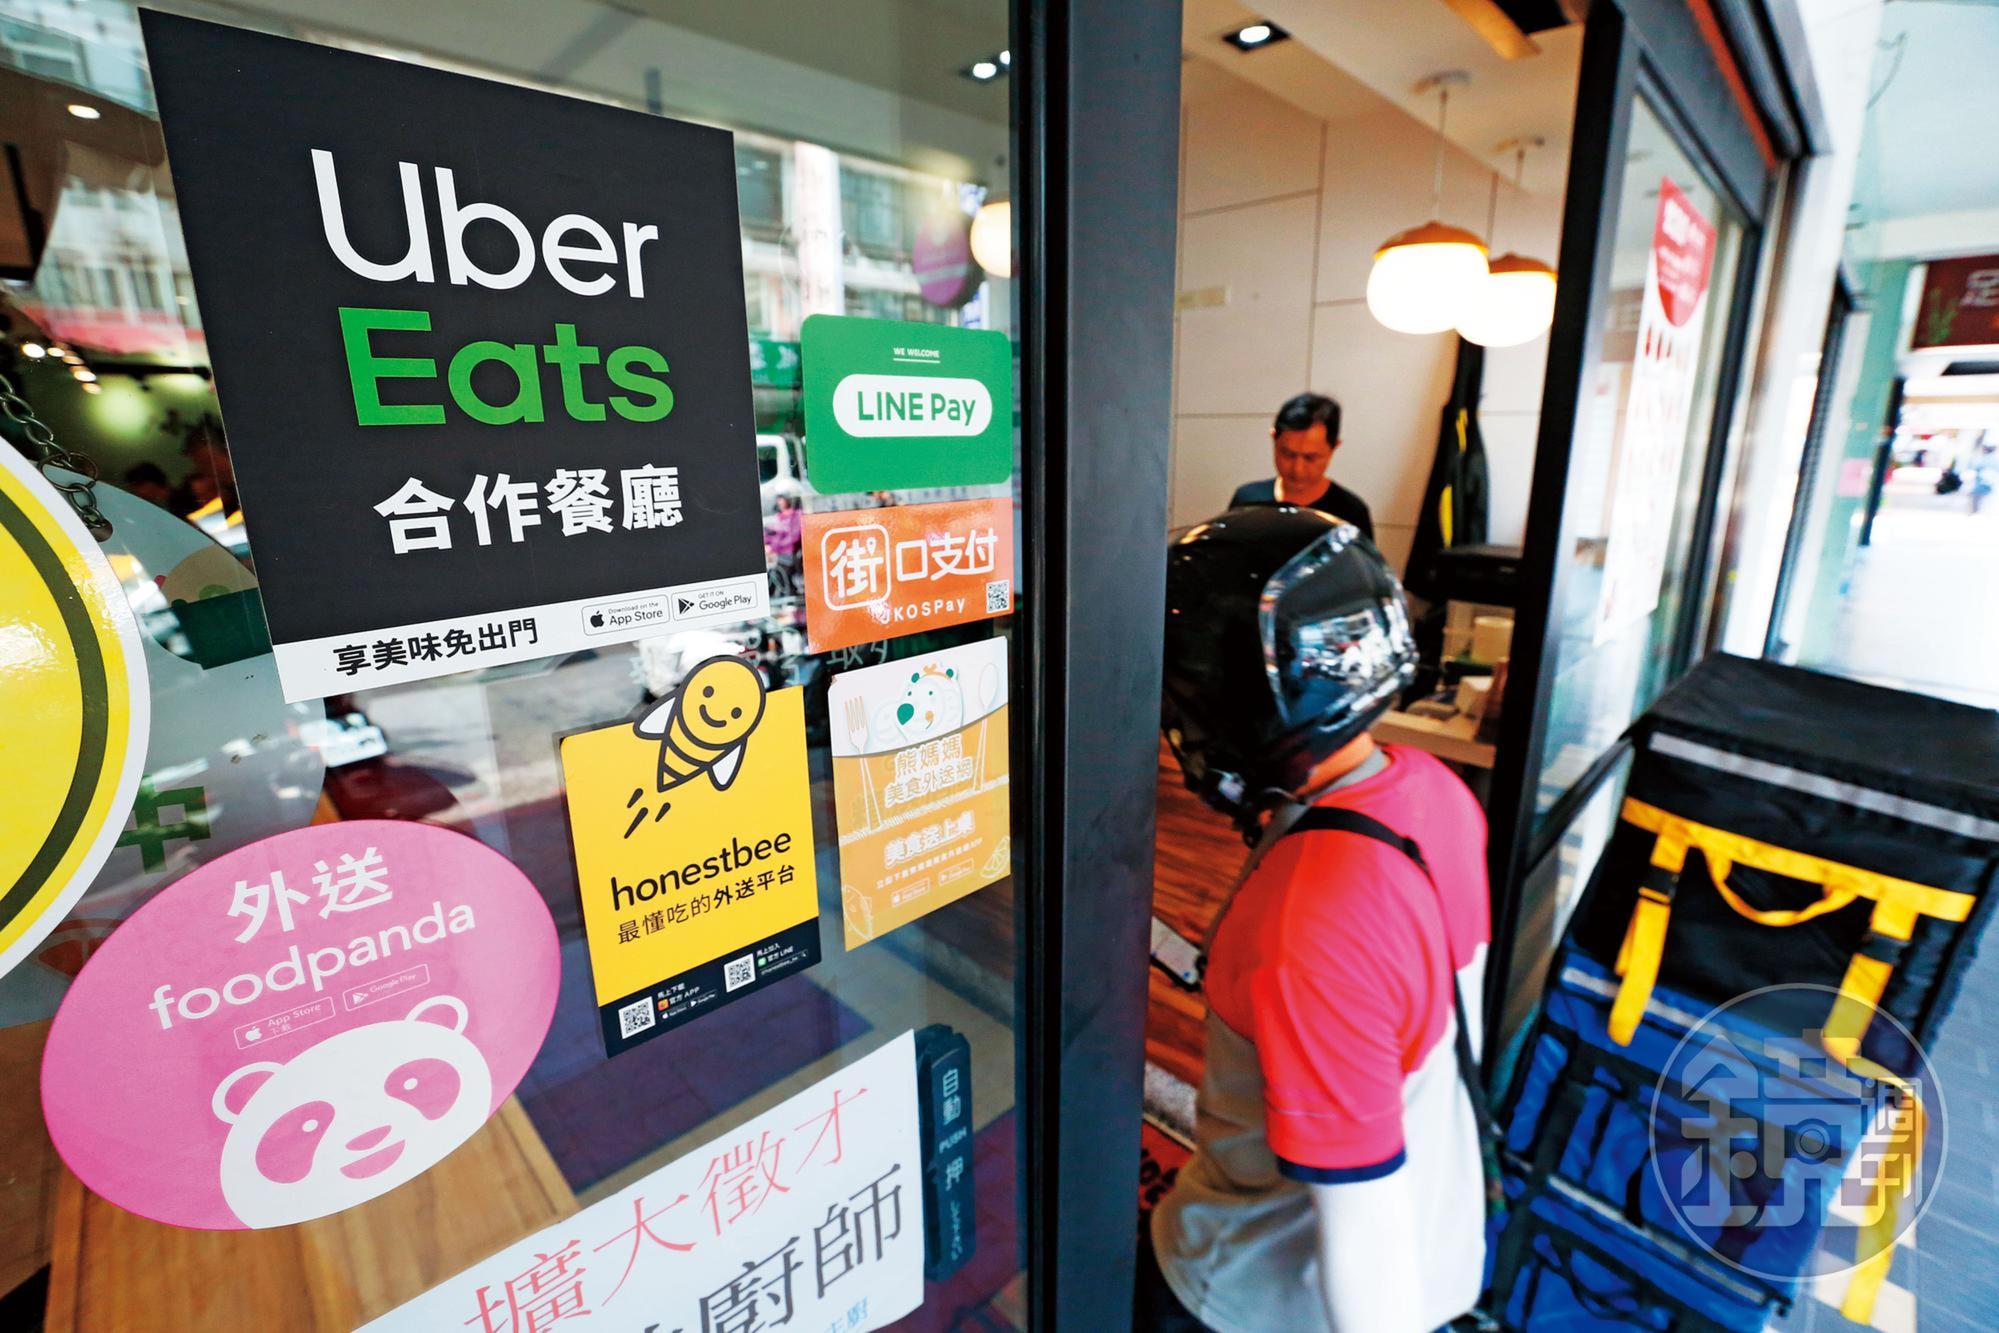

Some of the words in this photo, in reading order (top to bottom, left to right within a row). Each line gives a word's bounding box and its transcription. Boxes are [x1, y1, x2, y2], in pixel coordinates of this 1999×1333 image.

[311, 148, 659, 299] Uber
[338, 306, 675, 427] Eats
[893, 347, 905, 356] WE
[907, 348, 940, 358] WELCOME
[857, 391, 924, 421] LINE
[931, 393, 976, 426] Pay
[373, 463, 684, 555] 合作餐廳
[698, 591, 710, 599] GET
[829, 527, 998, 599] 街口支付
[608, 604, 638, 615] Download
[609, 612, 632, 627] App
[634, 608, 663, 621] Store
[699, 598, 732, 611] Google
[733, 594, 752, 605] Play
[333, 617, 538, 676] 享美味免出門
[227, 846, 393, 944] 外送
[611, 832, 791, 911] honestbee
[618, 864, 795, 944] 最懂吃的外送平台
[148, 900, 475, 1029] foodpanda
[268, 1014, 291, 1028] App
[293, 1003, 321, 1018] Store
[463, 1086, 869, 1333] 擴大徵才
